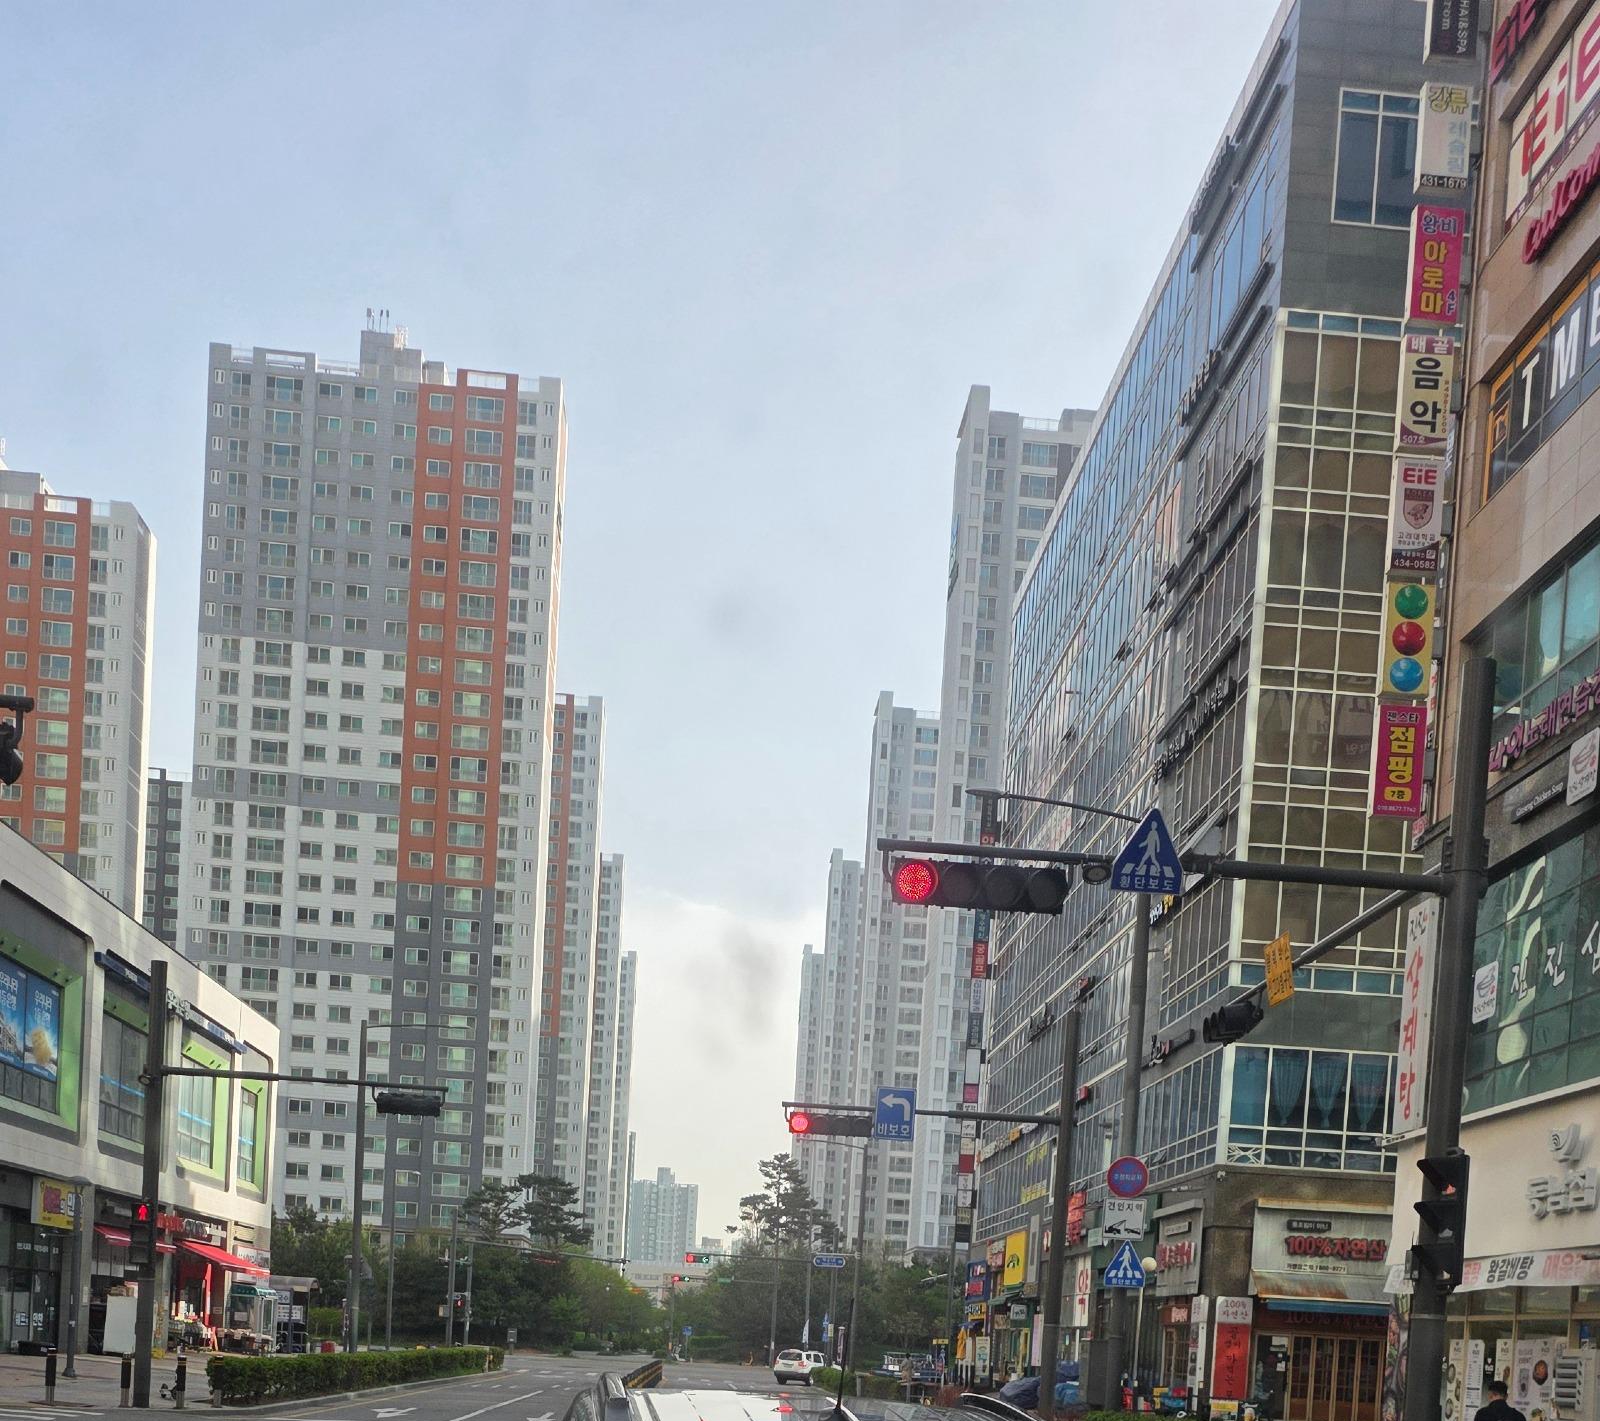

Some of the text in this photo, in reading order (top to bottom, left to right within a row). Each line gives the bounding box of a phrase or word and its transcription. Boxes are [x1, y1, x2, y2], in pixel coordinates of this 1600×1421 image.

[1421, 175, 1467, 189] 431-1679
[1422, 210, 1458, 236] 왕비
[1420, 240, 1448, 314] 아로마
[1446, 289, 1457, 316] 4F
[1410, 357, 1443, 434] 음악
[1402, 467, 1437, 486] EiE
[1397, 531, 1436, 541] 고려대학교
[1394, 559, 1436, 569] 434-0582
[1388, 725, 1415, 784] 점핑
[1390, 789, 1406, 800] 7층
[1119, 876, 1174, 892] 횡단보도
[877, 1122, 911, 1137] 비보호
[1107, 1201, 1143, 1213] 견인지역
[1486, 1255, 1535, 1284] 왕갈비탕
